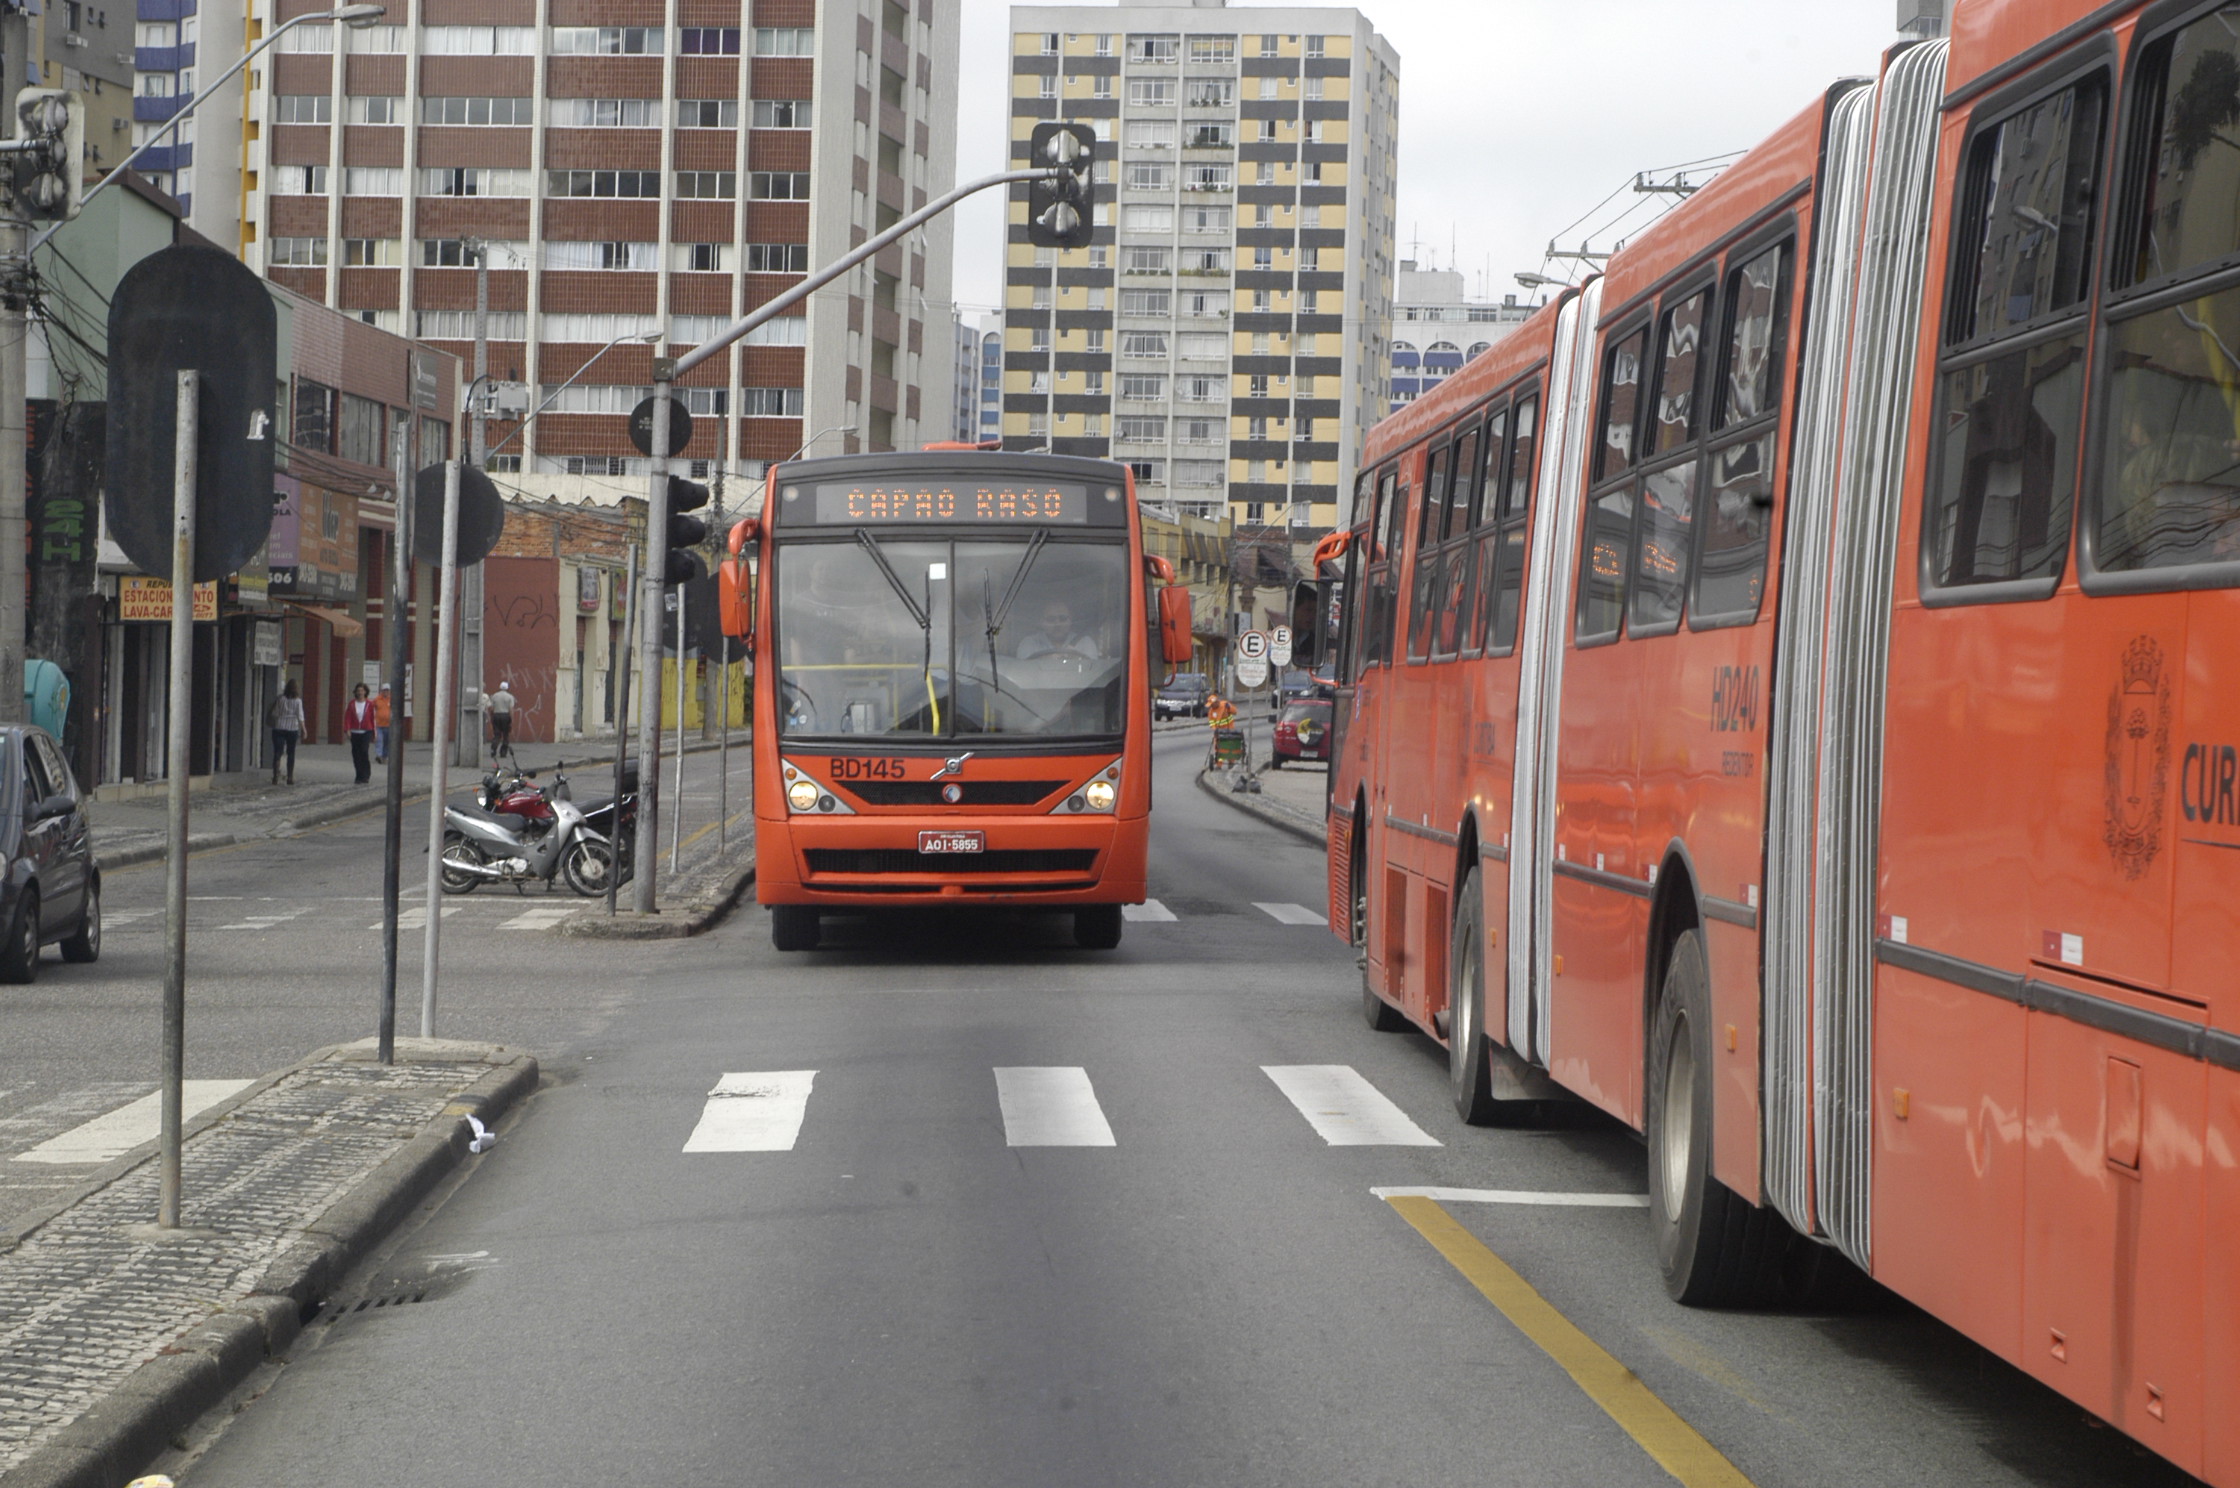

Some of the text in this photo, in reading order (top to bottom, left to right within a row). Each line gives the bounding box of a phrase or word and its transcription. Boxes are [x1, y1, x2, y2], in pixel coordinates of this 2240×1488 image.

[976, 488, 1062, 518] RASO
[43, 500, 84, 561] 24H
[1247, 636, 1260, 652] E
[1278, 630, 1287, 642] E
[1710, 665, 1759, 732] HD240
[830, 758, 905, 778] BD145
[2180, 742, 2240, 826] CUR
